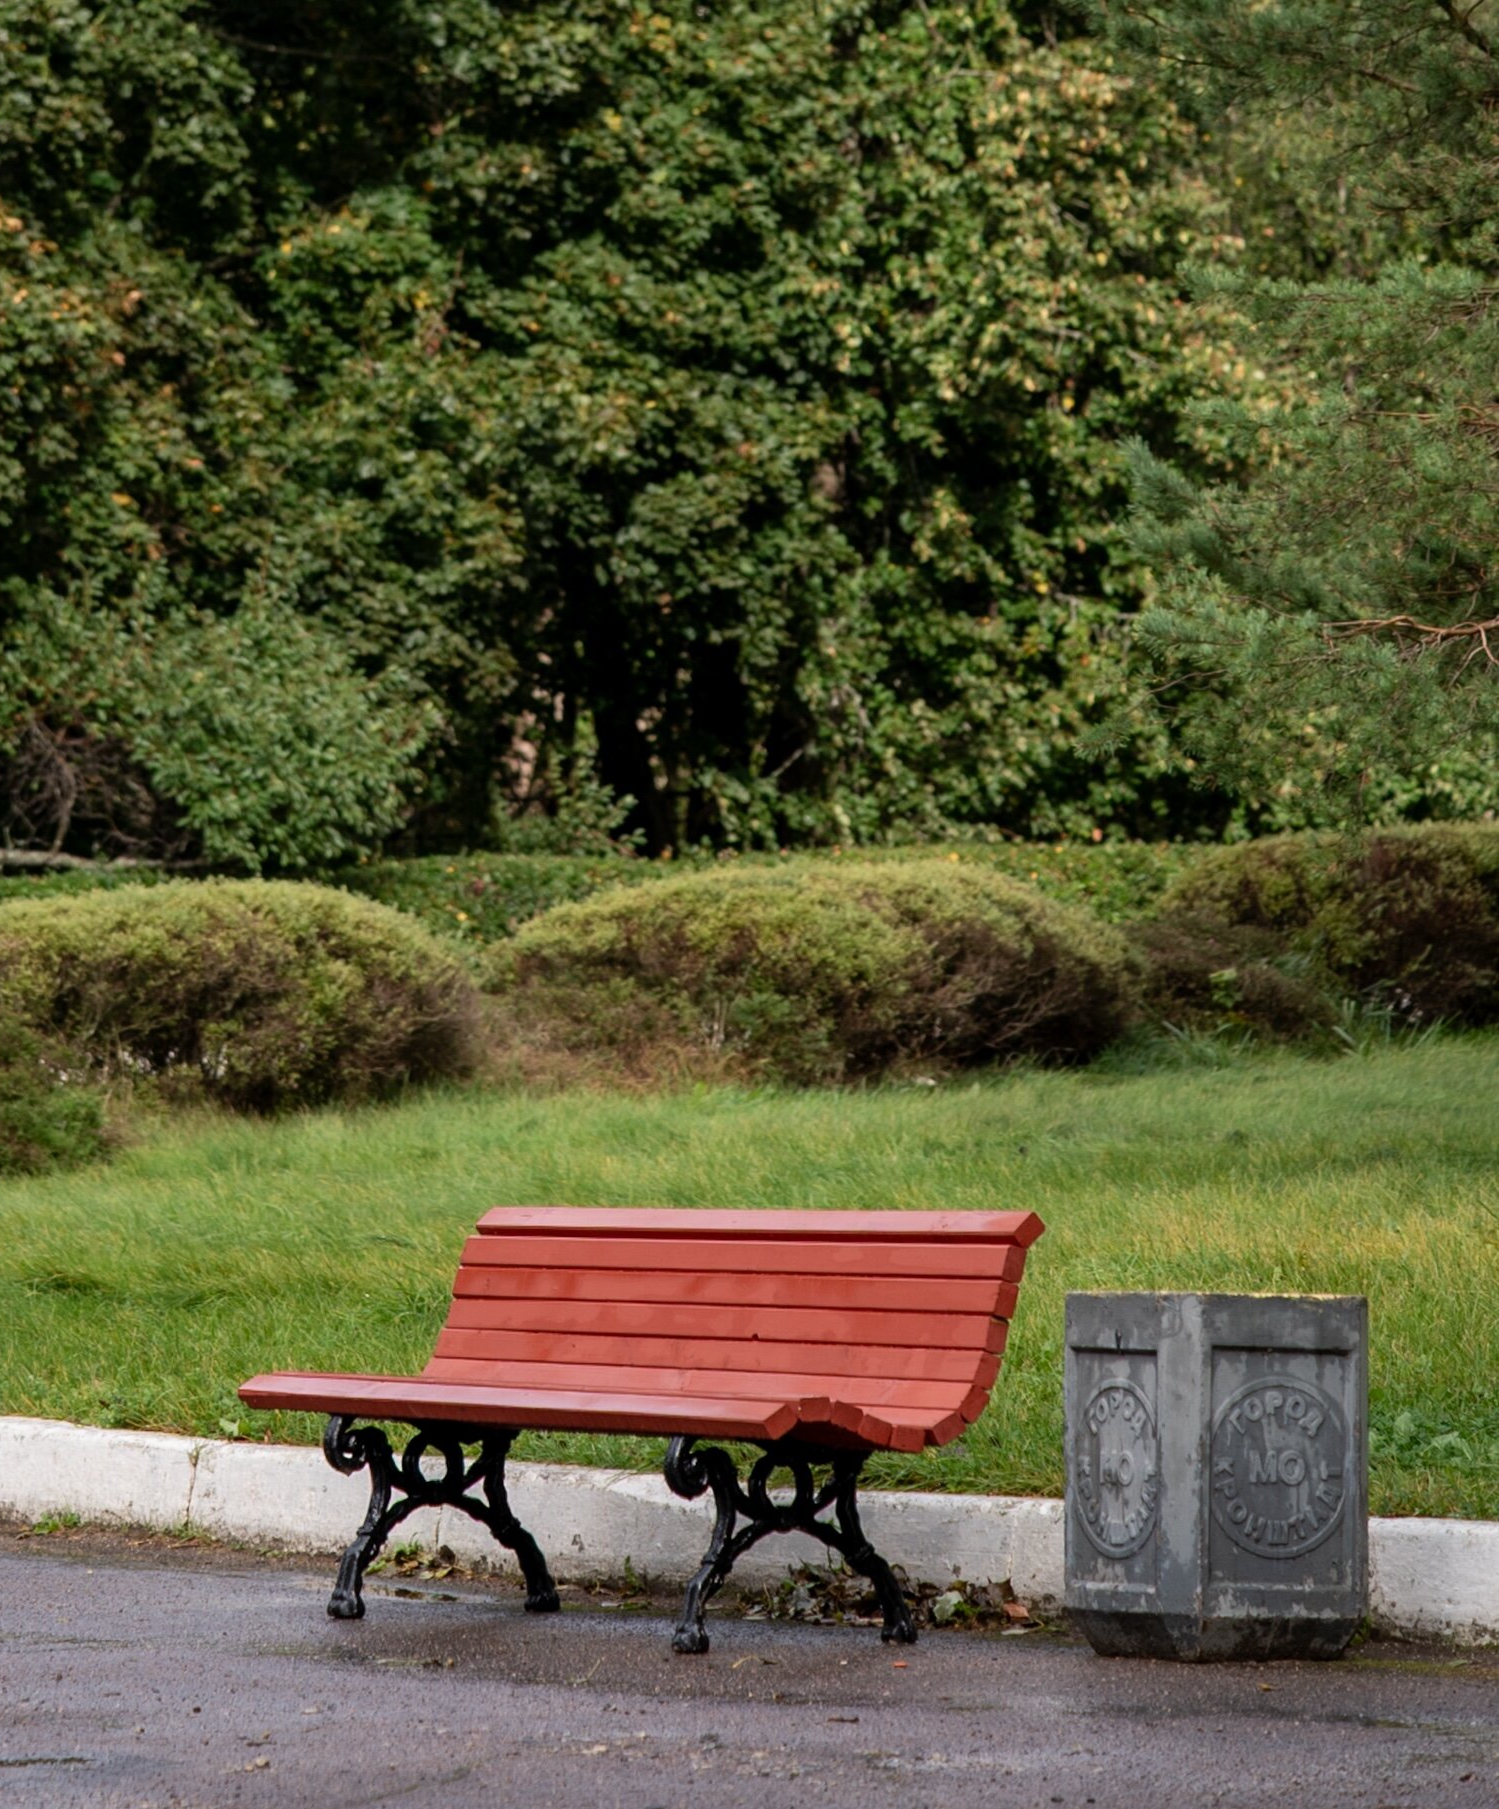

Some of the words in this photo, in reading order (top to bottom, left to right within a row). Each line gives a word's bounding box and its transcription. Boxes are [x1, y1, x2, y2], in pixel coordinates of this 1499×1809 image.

[1087, 1391, 1147, 1438] ГОРОД
[1229, 1391, 1325, 1439] ГОРОД
[1250, 1448, 1306, 1486] МО
[1214, 1454, 1342, 1545] КРОНШТАДТ
